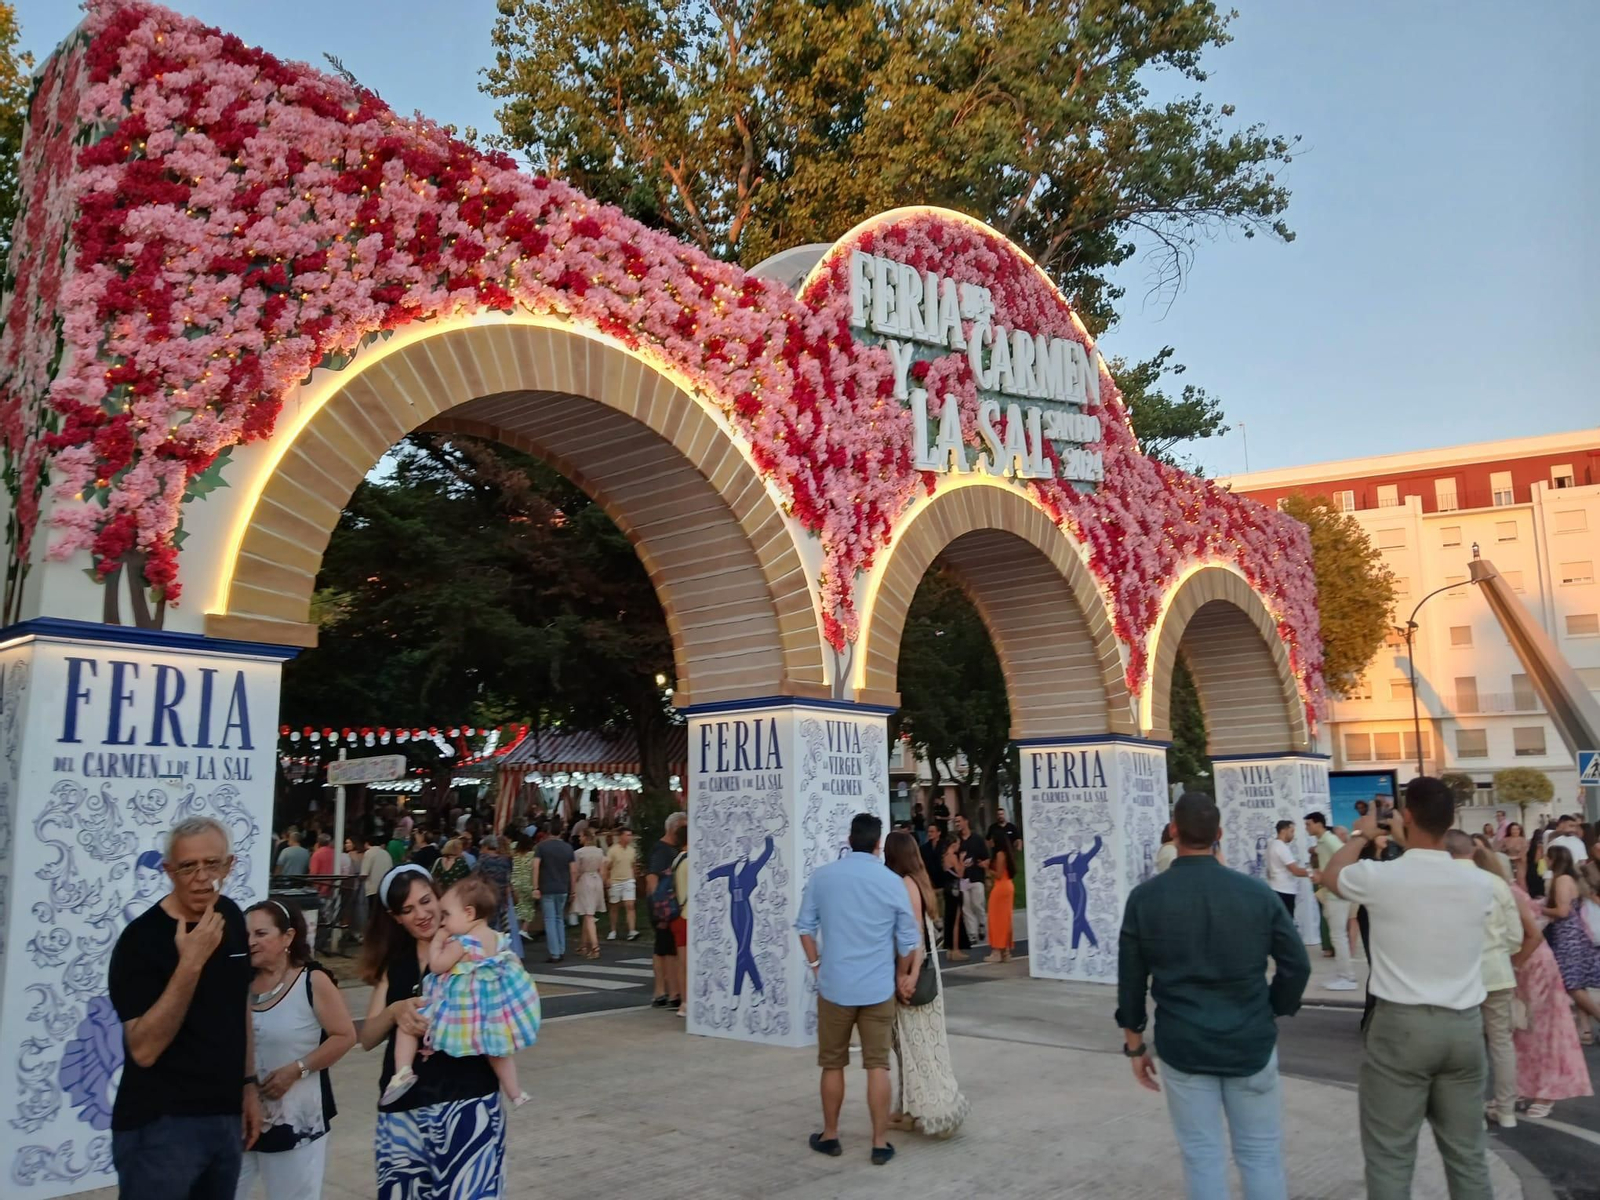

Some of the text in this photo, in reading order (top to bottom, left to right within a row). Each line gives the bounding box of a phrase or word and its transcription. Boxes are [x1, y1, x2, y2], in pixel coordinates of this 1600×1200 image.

[852, 249, 967, 350] FERIA
[886, 322, 1100, 406] Y CARMEN
[909, 388, 1054, 480] LA SAL
[57, 656, 255, 750] FERIA
[699, 717, 783, 773] FERIA
[826, 720, 861, 754] VIVA
[53, 751, 252, 781] DEL CARMEN Y DE LA SAL
[829, 756, 862, 776] VIRGEN
[1030, 750, 1108, 790] FERIA
[1132, 752, 1153, 777] VIVA
[1240, 765, 1273, 785] VIVA
[709, 776, 740, 792] CARMEN
[756, 774, 766, 790] LA
[768, 773, 783, 790] SAL
[831, 778, 862, 796] CARMEN
[1244, 786, 1274, 798] VIRGEN
[1247, 799, 1276, 809] CARMEN
